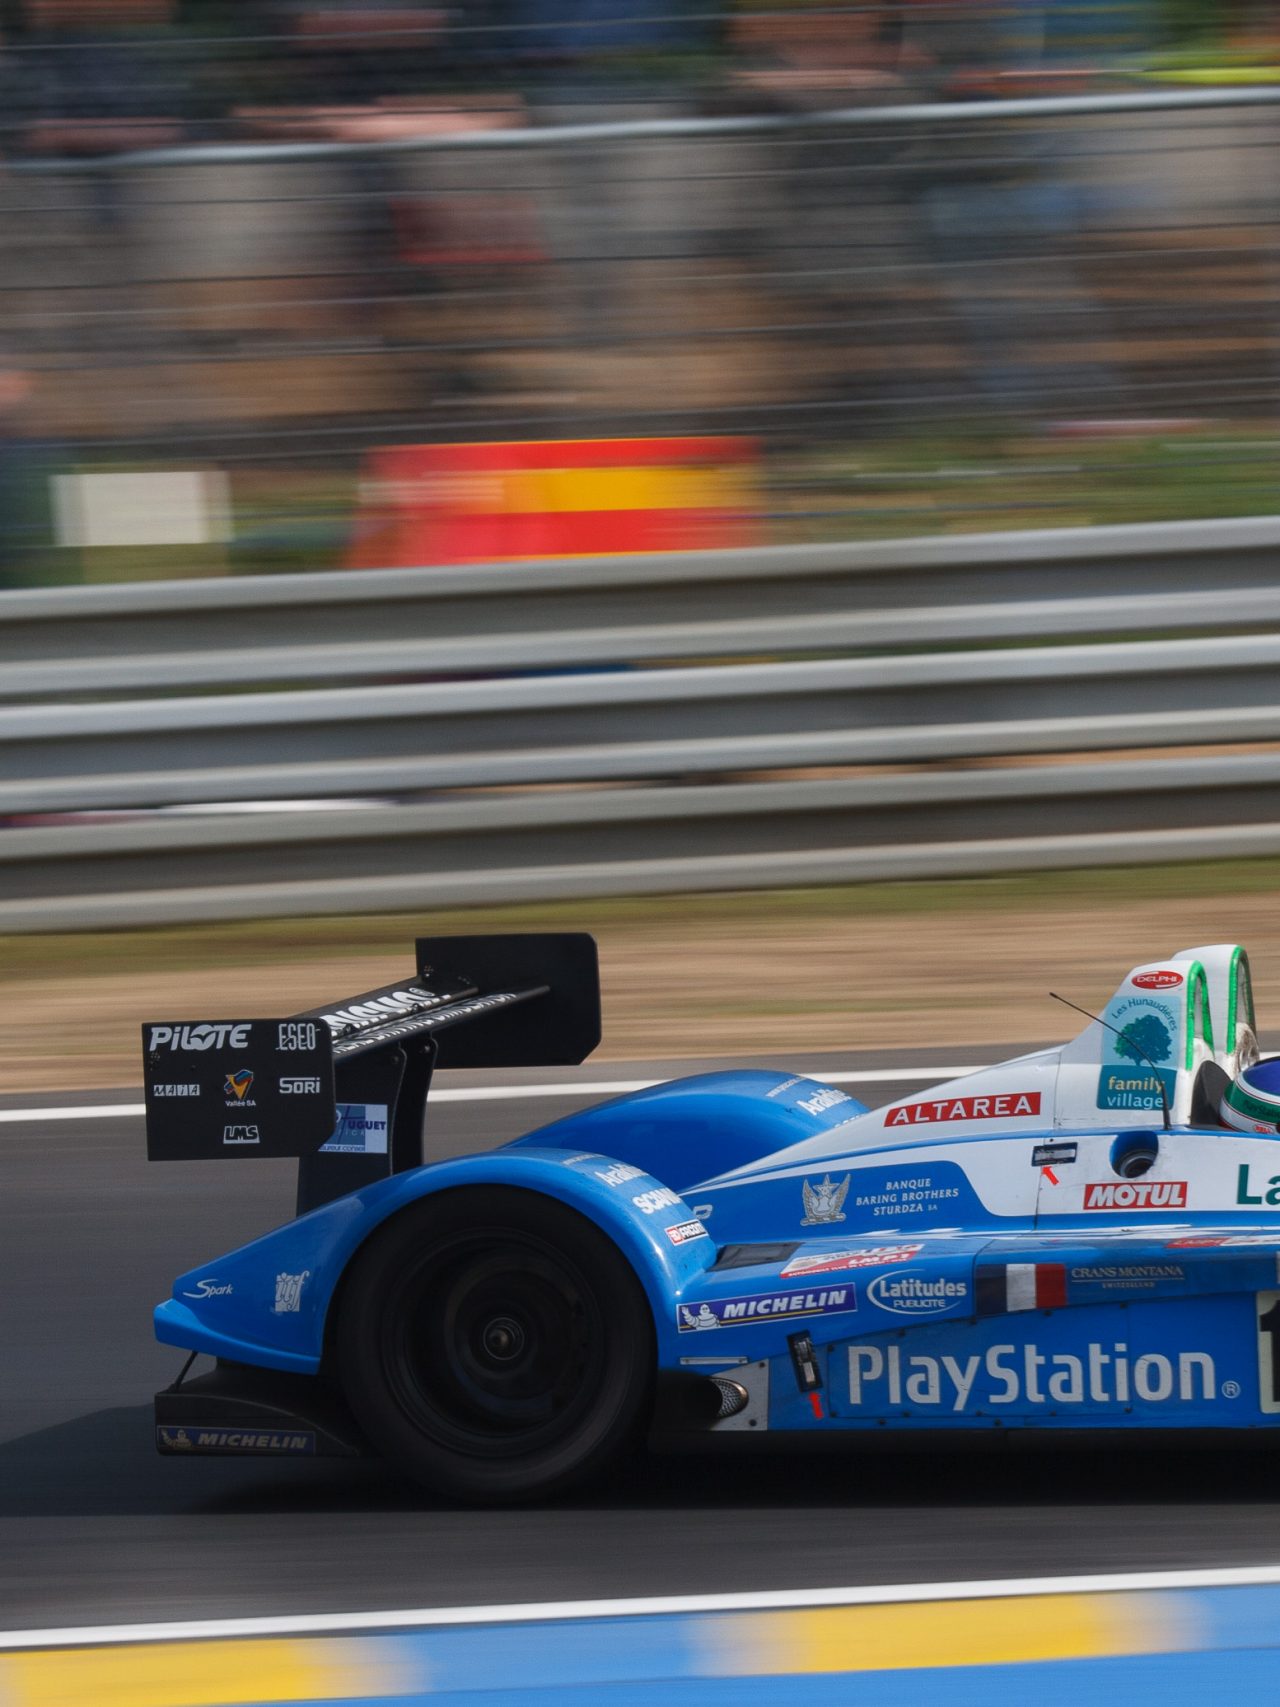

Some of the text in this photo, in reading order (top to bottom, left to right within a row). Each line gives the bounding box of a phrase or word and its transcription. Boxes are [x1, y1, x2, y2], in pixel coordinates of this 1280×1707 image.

[1136, 975, 1178, 983] DELPHI
[1111, 1004, 1128, 1019] Les
[1108, 1076, 1165, 1093] family
[892, 1095, 1033, 1125] ALTAREA
[1107, 1093, 1164, 1110] village
[886, 1178, 931, 1191] BANQUE
[856, 1188, 960, 1206] BARING BROTHERS
[1087, 1183, 1184, 1207] MOTUL
[873, 1203, 924, 1216] STURDZA
[1071, 1265, 1184, 1278] CRANS MONTANA
[182, 1279, 234, 1299] Spark
[880, 1278, 967, 1297] Latitudes
[722, 1289, 847, 1319] MICHELIN
[197, 1432, 309, 1449] MICHELIN
